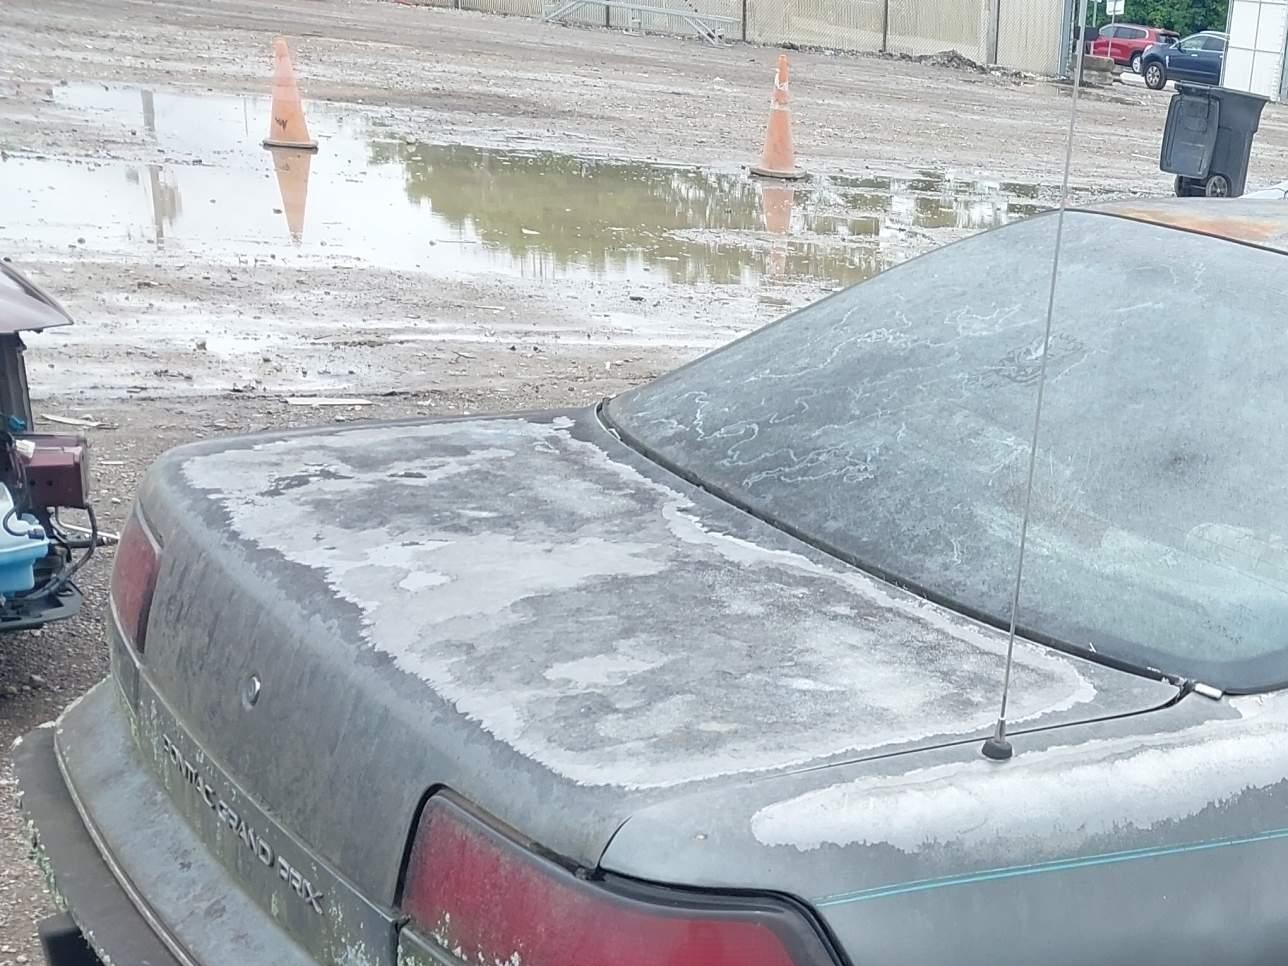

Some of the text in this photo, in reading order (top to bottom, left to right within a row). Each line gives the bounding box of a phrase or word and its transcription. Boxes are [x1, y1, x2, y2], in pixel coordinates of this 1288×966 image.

[162, 734, 325, 915] PONTIAC GRAND PRIX
